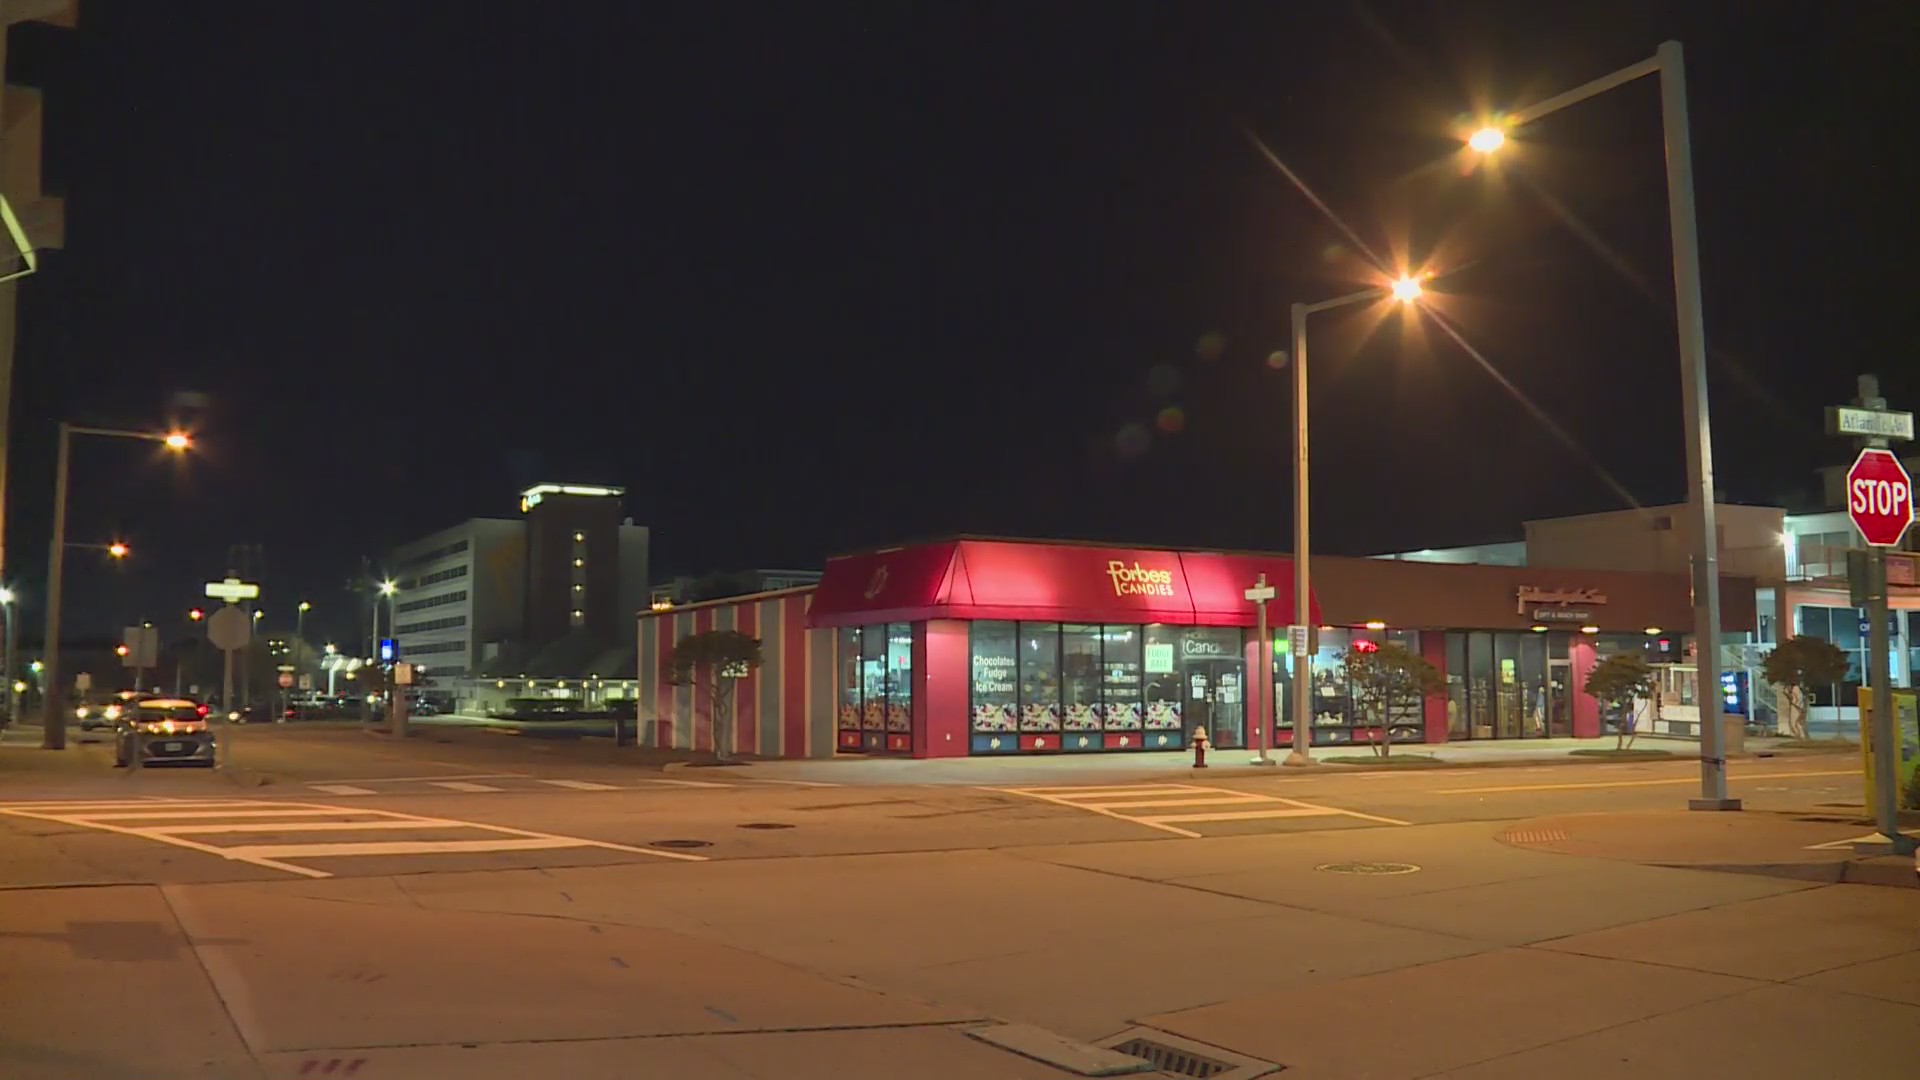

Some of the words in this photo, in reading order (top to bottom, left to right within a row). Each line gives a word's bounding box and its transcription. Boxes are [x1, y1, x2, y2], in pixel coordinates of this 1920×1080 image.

[1853, 478, 1907, 516] STOP
[1106, 560, 1172, 597] Forbes
[1120, 582, 1174, 596] CANDIES
[1186, 639, 1222, 654] Cand
[973, 655, 1015, 666] Chocolates
[983, 667, 1007, 680] Fudge
[976, 681, 988, 692] Ice
[989, 681, 1013, 692] Cream
